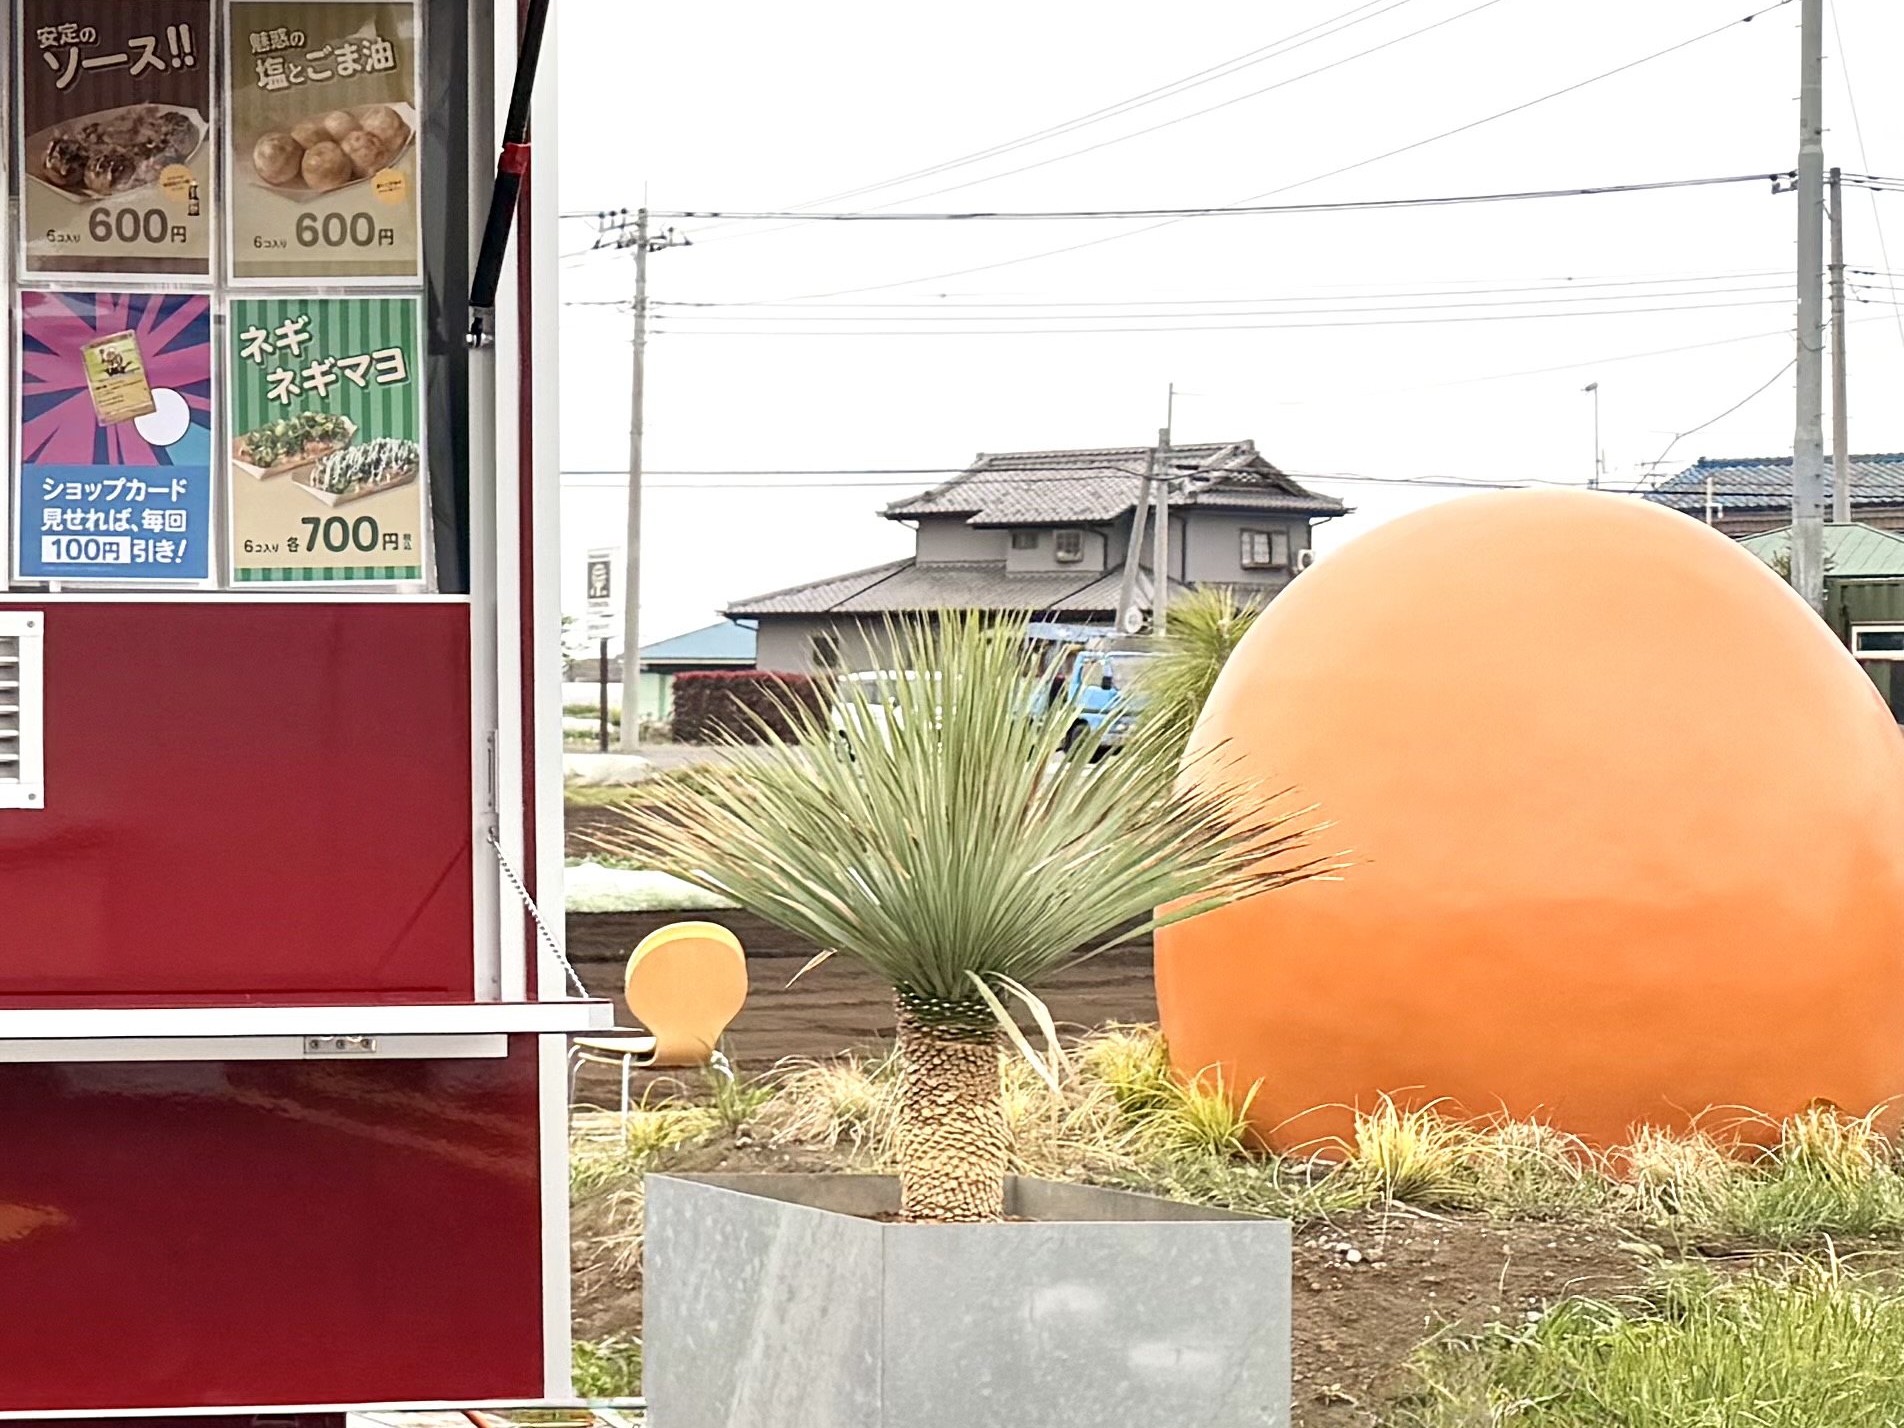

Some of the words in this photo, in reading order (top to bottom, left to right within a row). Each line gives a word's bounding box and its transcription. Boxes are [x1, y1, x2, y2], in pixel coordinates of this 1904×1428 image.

[37, 23, 96, 48] 安定の
[250, 28, 305, 54] 魅惑の
[43, 24, 195, 89] ソース!!
[255, 37, 395, 90] 塩とごま油
[89, 207, 187, 244] 600円
[295, 212, 394, 248] 600円
[240, 315, 310, 363] ネギ
[266, 347, 407, 405] ネギマヨ
[42, 477, 188, 502] ショップカード
[41, 507, 187, 533] 見せれば、毎回
[243, 539, 279, 554] 6コ入り
